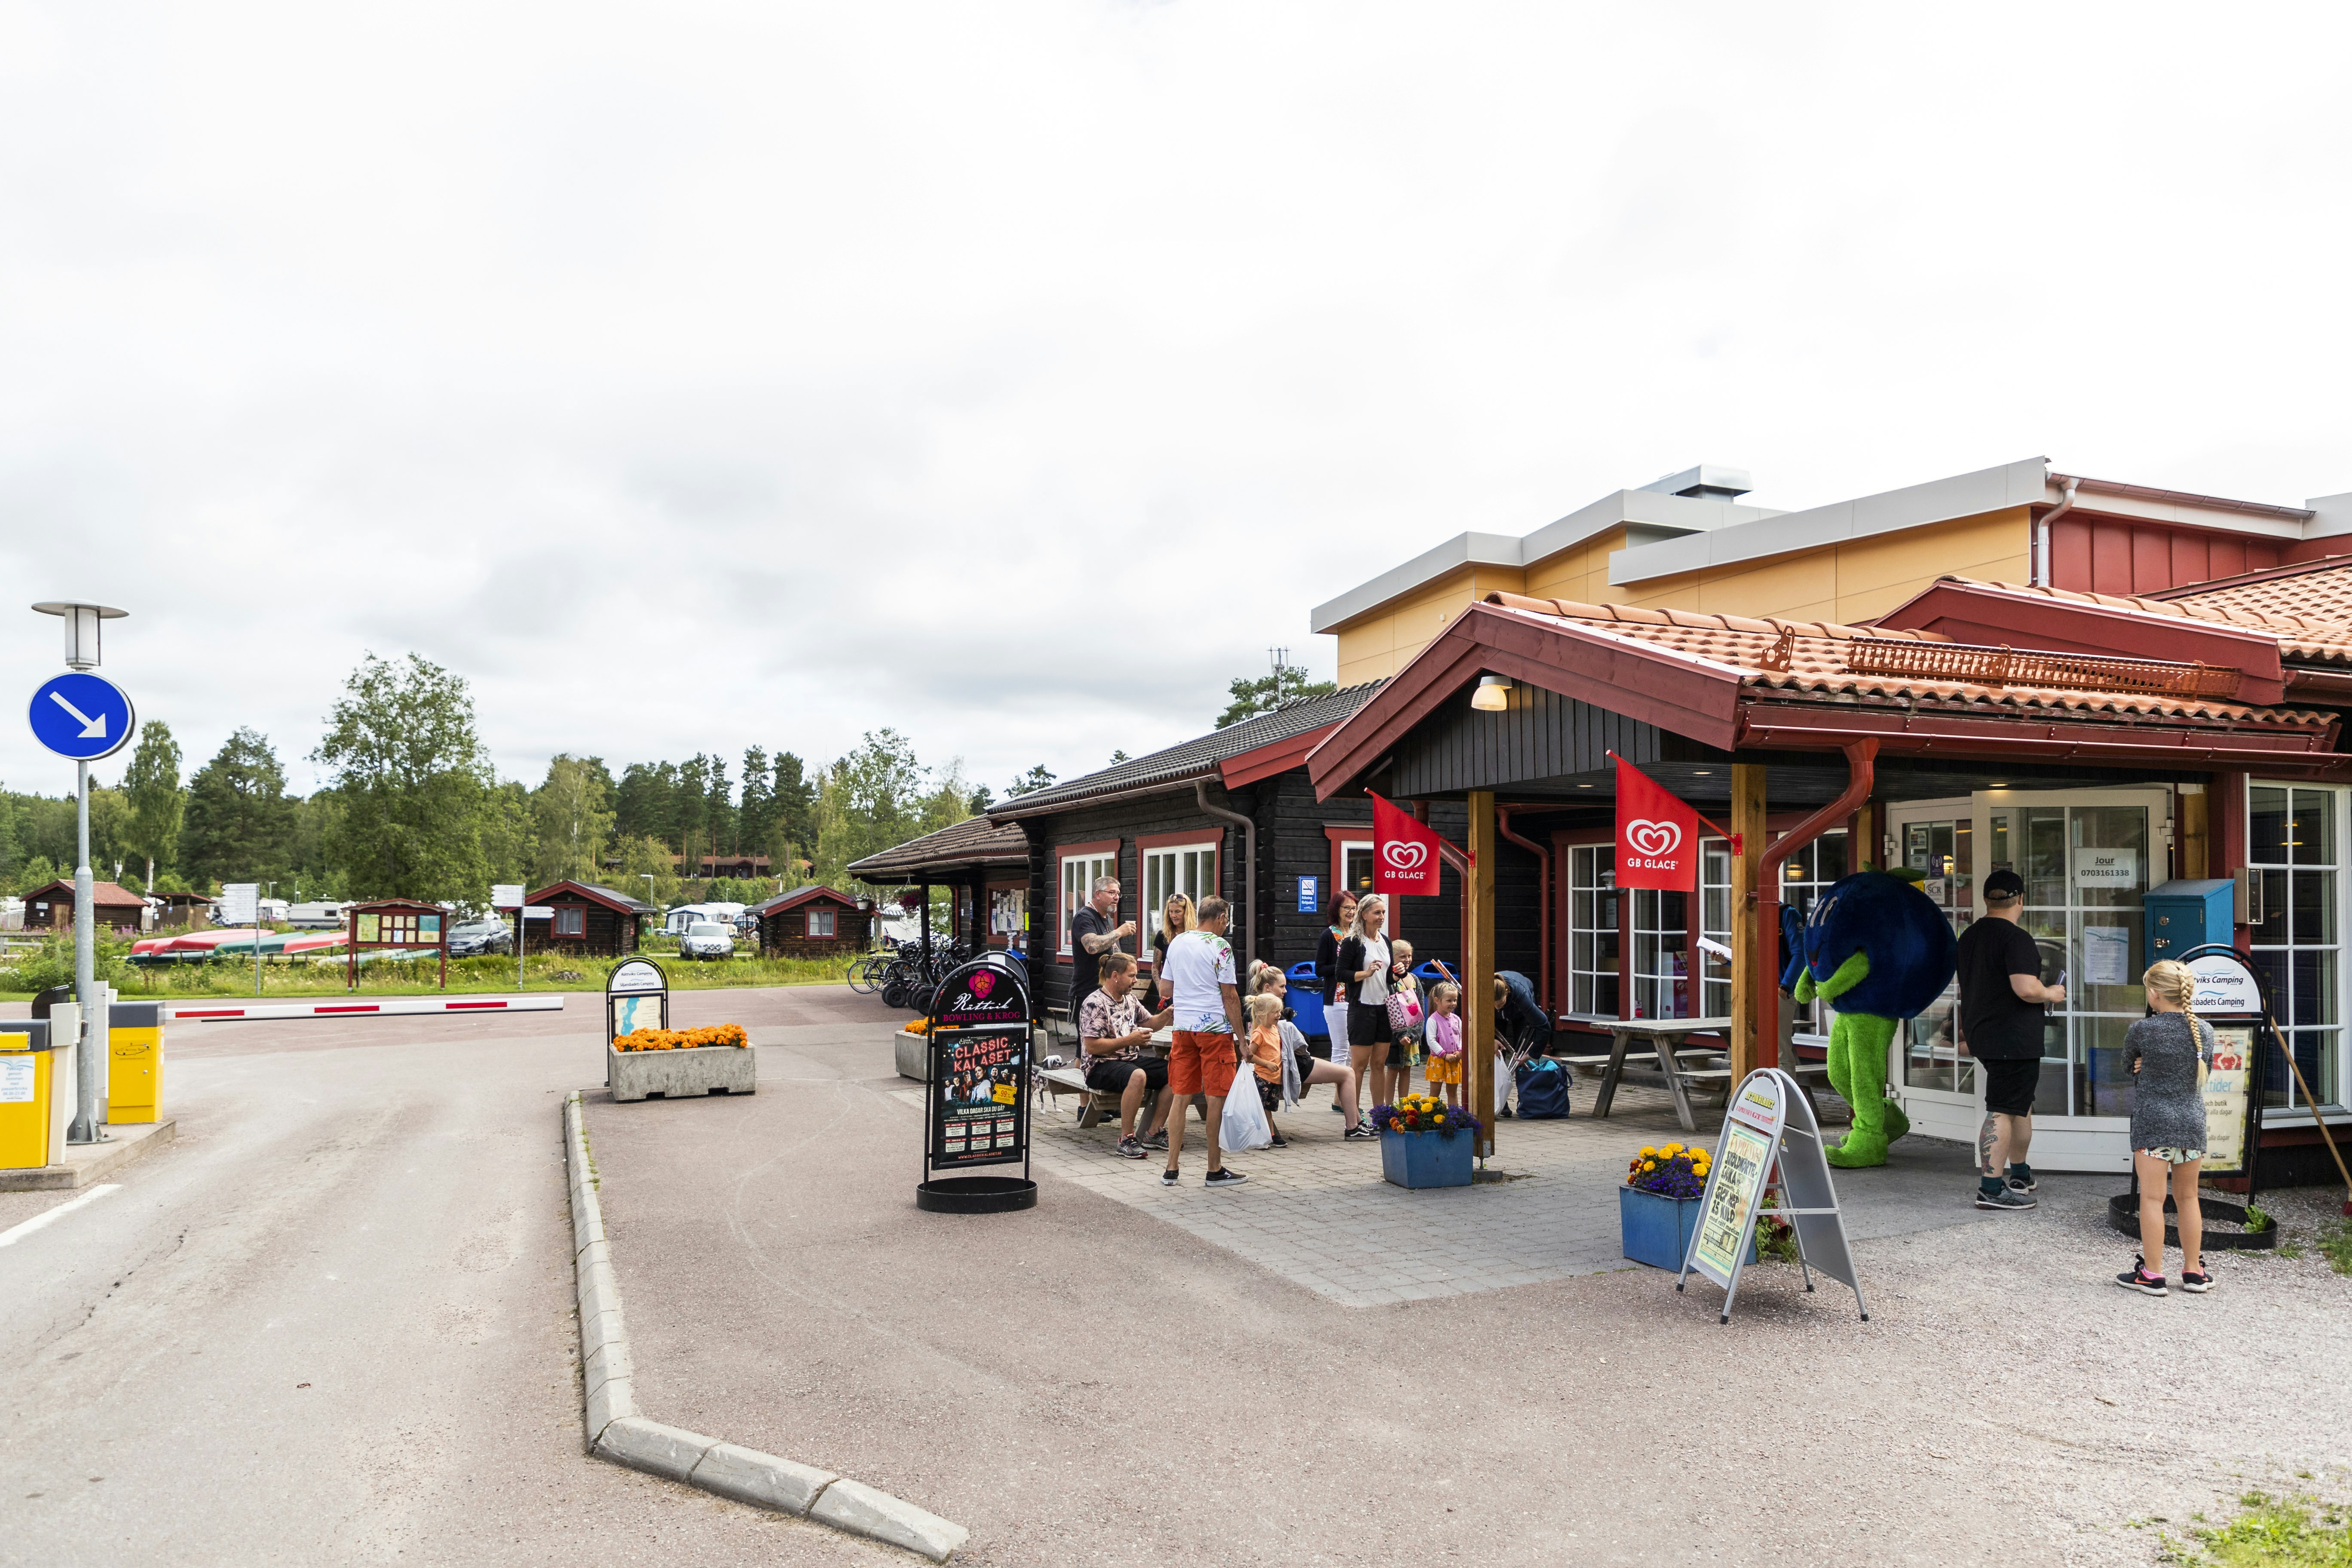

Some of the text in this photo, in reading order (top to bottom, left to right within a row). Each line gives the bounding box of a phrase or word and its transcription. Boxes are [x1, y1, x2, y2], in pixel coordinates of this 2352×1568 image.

[1627, 858, 1675, 870] GB GLACE
[2095, 857, 2115, 865] Jour
[2212, 976, 2243, 985] Camping
[952, 993, 1013, 1011] Rättvik
[2218, 998, 2244, 1007] Camping
[943, 1013, 985, 1022] BOWLING
[955, 1036, 1008, 1059] CLASSIC
[1745, 1091, 1775, 1110] AFTONBLADET
[1736, 1105, 1761, 1120] EXPRESSEN GT
[958, 1151, 1002, 1159] WWW.CLASSICKALASET.SE
[1721, 1165, 1737, 1185] SJUKA
[1715, 1185, 1739, 1209] GICK NER
[1711, 1199, 1735, 1224] 25 KILO
[1709, 1216, 1739, 1237] med rätt medicin
